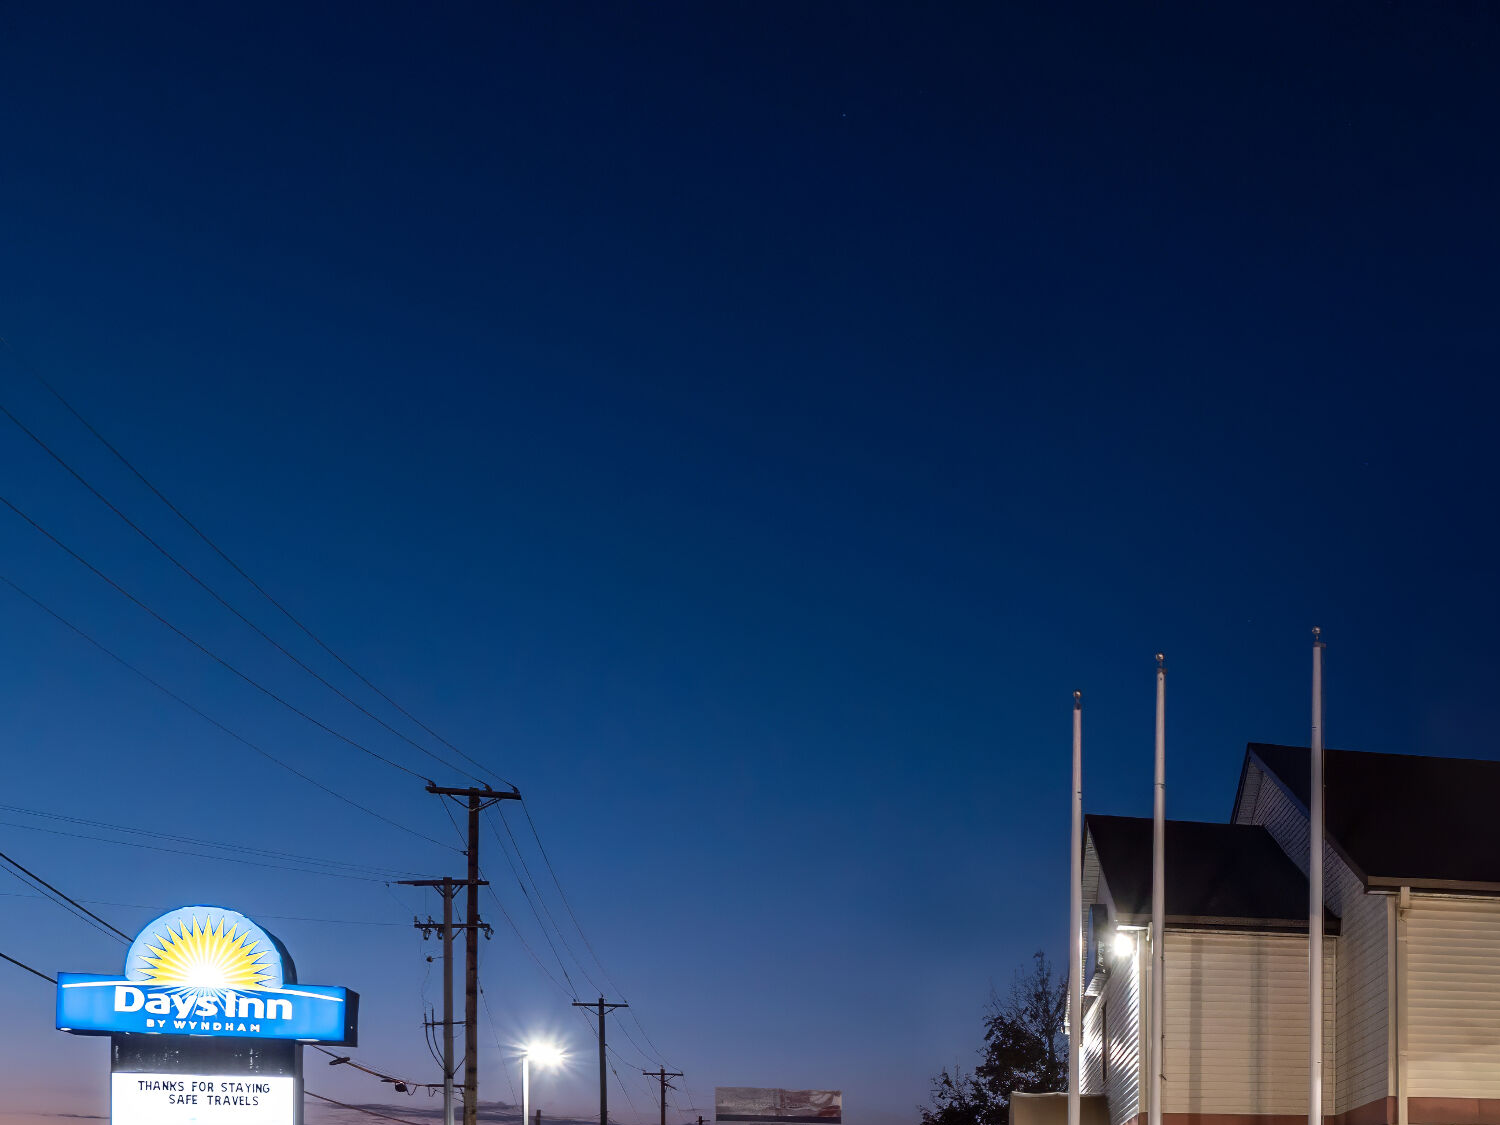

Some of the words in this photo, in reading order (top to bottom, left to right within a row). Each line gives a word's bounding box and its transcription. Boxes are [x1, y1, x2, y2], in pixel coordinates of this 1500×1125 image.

[114, 986, 218, 1019] Days
[225, 992, 293, 1020] Inn
[146, 1019, 166, 1028] BY
[174, 1020, 260, 1033] WYNDHAM
[138, 1080, 185, 1092] THANKS
[191, 1081, 214, 1093] FOR
[221, 1083, 270, 1094] STAYING
[168, 1094, 198, 1105] SAFE
[207, 1095, 259, 1106] TRAVELS
